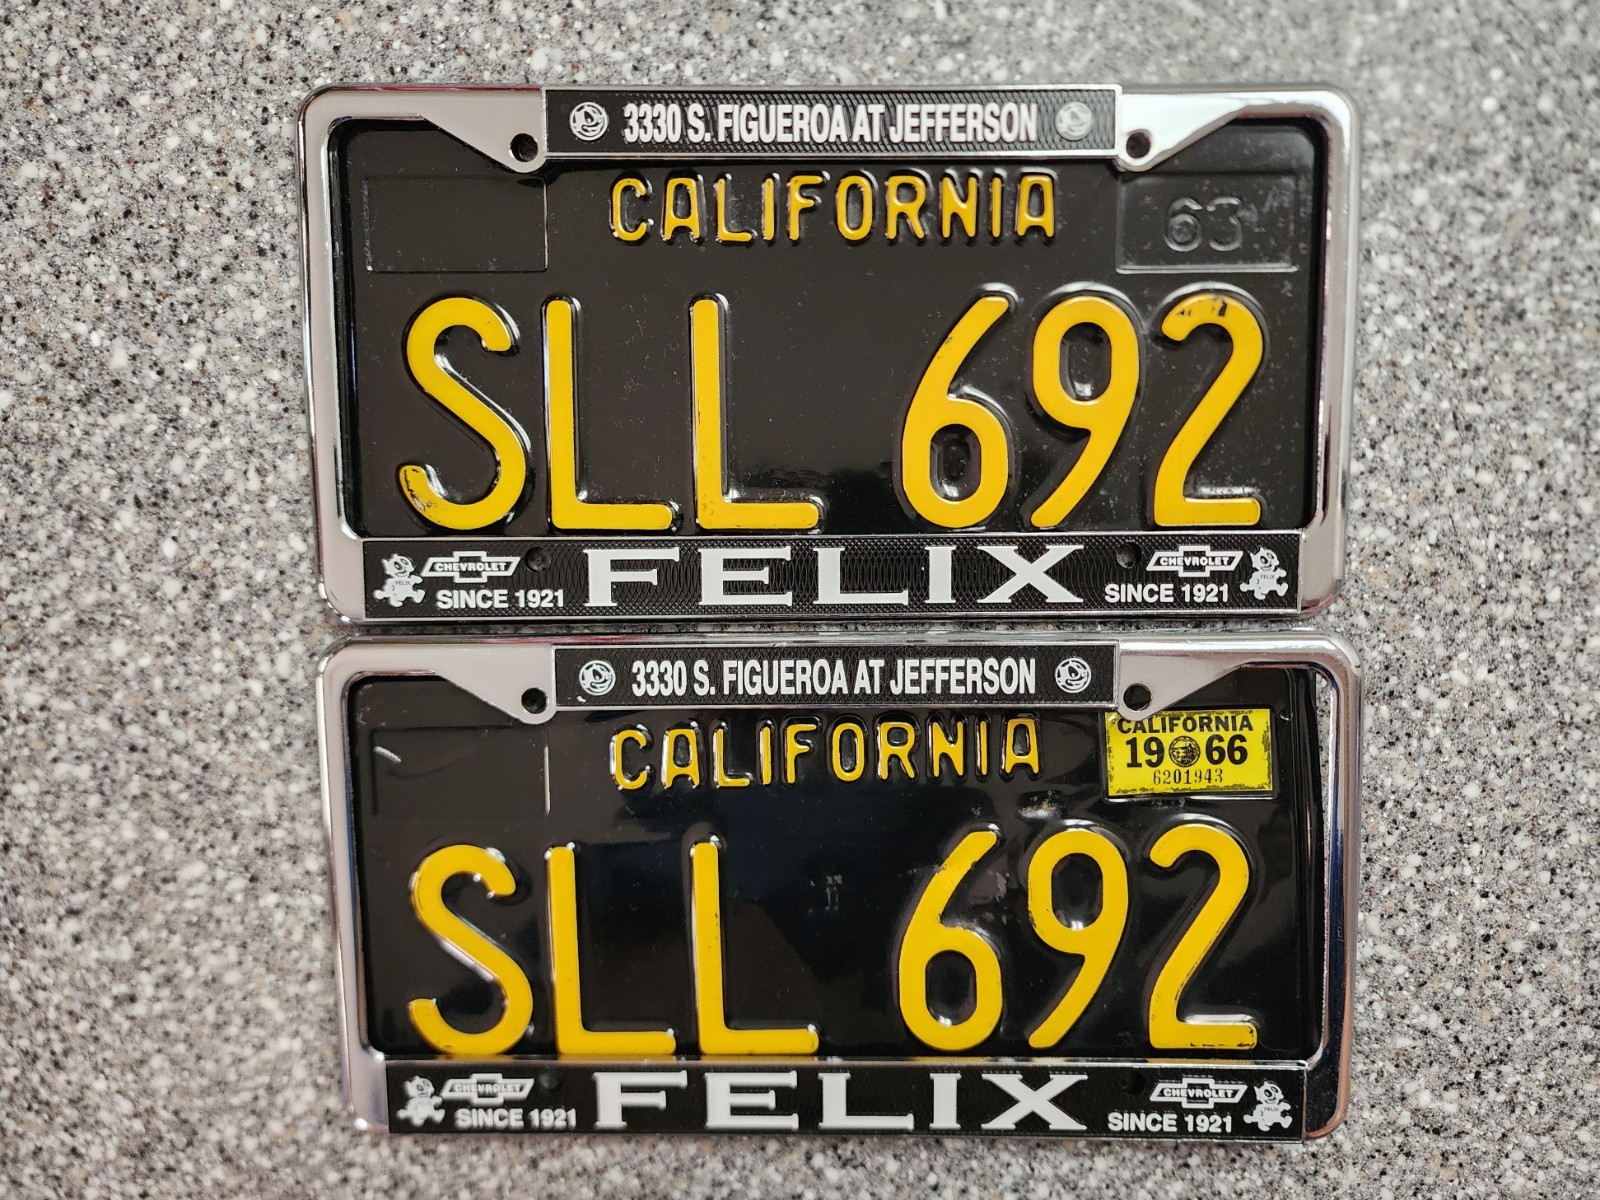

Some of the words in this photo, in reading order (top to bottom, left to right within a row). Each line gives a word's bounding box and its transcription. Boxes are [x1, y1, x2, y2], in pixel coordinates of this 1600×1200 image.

[623, 104, 681, 143] 3330
[687, 104, 712, 143] S.
[718, 104, 848, 143] FIGUEROA
[850, 104, 886, 142] AT
[888, 103, 1037, 142] JEFFERSON
[610, 173, 1056, 243] CALIFORNIA
[1164, 197, 1243, 251] 63
[400, 296, 821, 531] SLL
[901, 293, 1264, 529] 692
[434, 561, 507, 573] CHEVROLET
[1158, 556, 1230, 567] CHEVROLET
[583, 545, 1085, 607] FELIX
[436, 589, 508, 610] SINCE
[513, 588, 564, 609] 1921
[1104, 583, 1173, 604] SINCE
[1180, 582, 1229, 603] 1921
[632, 660, 687, 696] 3330
[693, 660, 716, 695] S.
[723, 659, 846, 696] FIGUEROA
[853, 659, 881, 694] AT
[890, 658, 1036, 695] JEFFERSON
[1117, 715, 1254, 734] CALIFORNIA
[611, 717, 1040, 791] CALIFORNIA
[1126, 737, 1165, 768] 19
[1205, 734, 1248, 765] 66
[1153, 768, 1223, 785] 6201943
[408, 841, 820, 1056] SLL
[899, 824, 1257, 1051] 692
[453, 1083, 522, 1094] CHEVROLET
[592, 1069, 1088, 1130] FELIX
[1162, 1087, 1235, 1099] CHEVROLET
[455, 1108, 524, 1129] SINCE
[528, 1108, 577, 1129] 1921
[1107, 1112, 1177, 1133] SINCE
[1184, 1112, 1232, 1133] 1921
